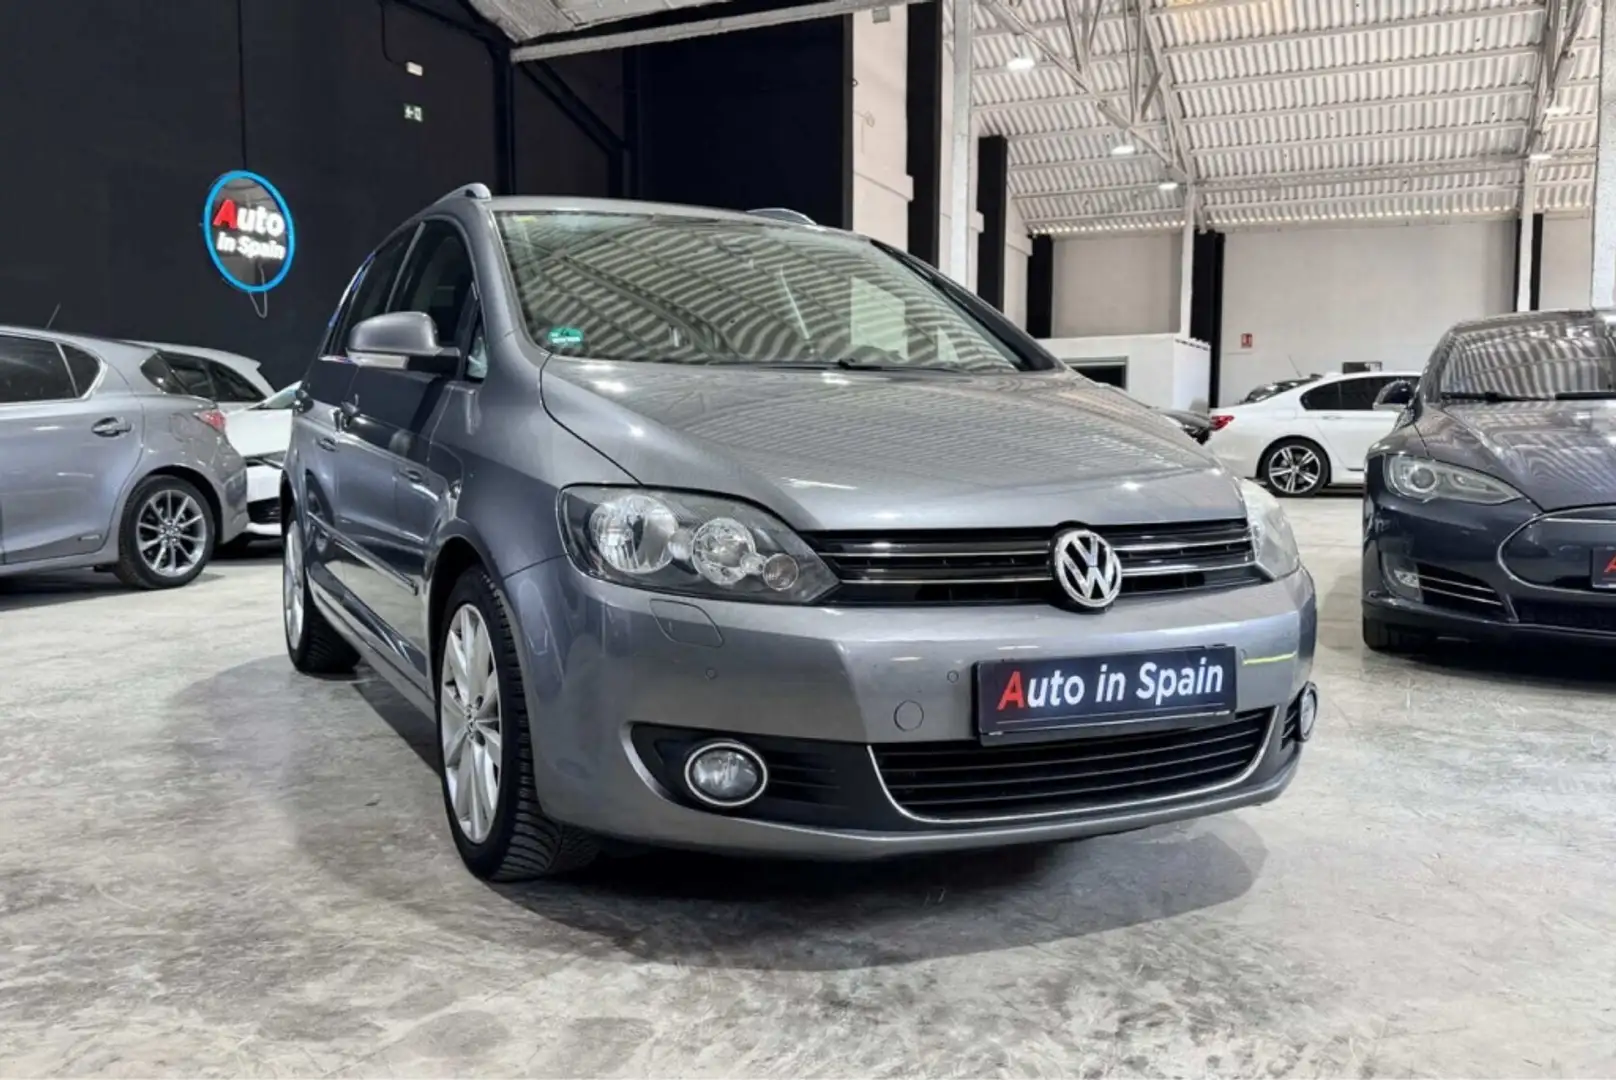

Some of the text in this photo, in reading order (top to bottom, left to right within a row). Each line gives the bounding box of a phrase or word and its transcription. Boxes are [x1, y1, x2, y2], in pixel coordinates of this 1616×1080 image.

[212, 199, 286, 237] Auto
[216, 231, 286, 260] in Spain
[996, 656, 1224, 711] Auto in Spain
